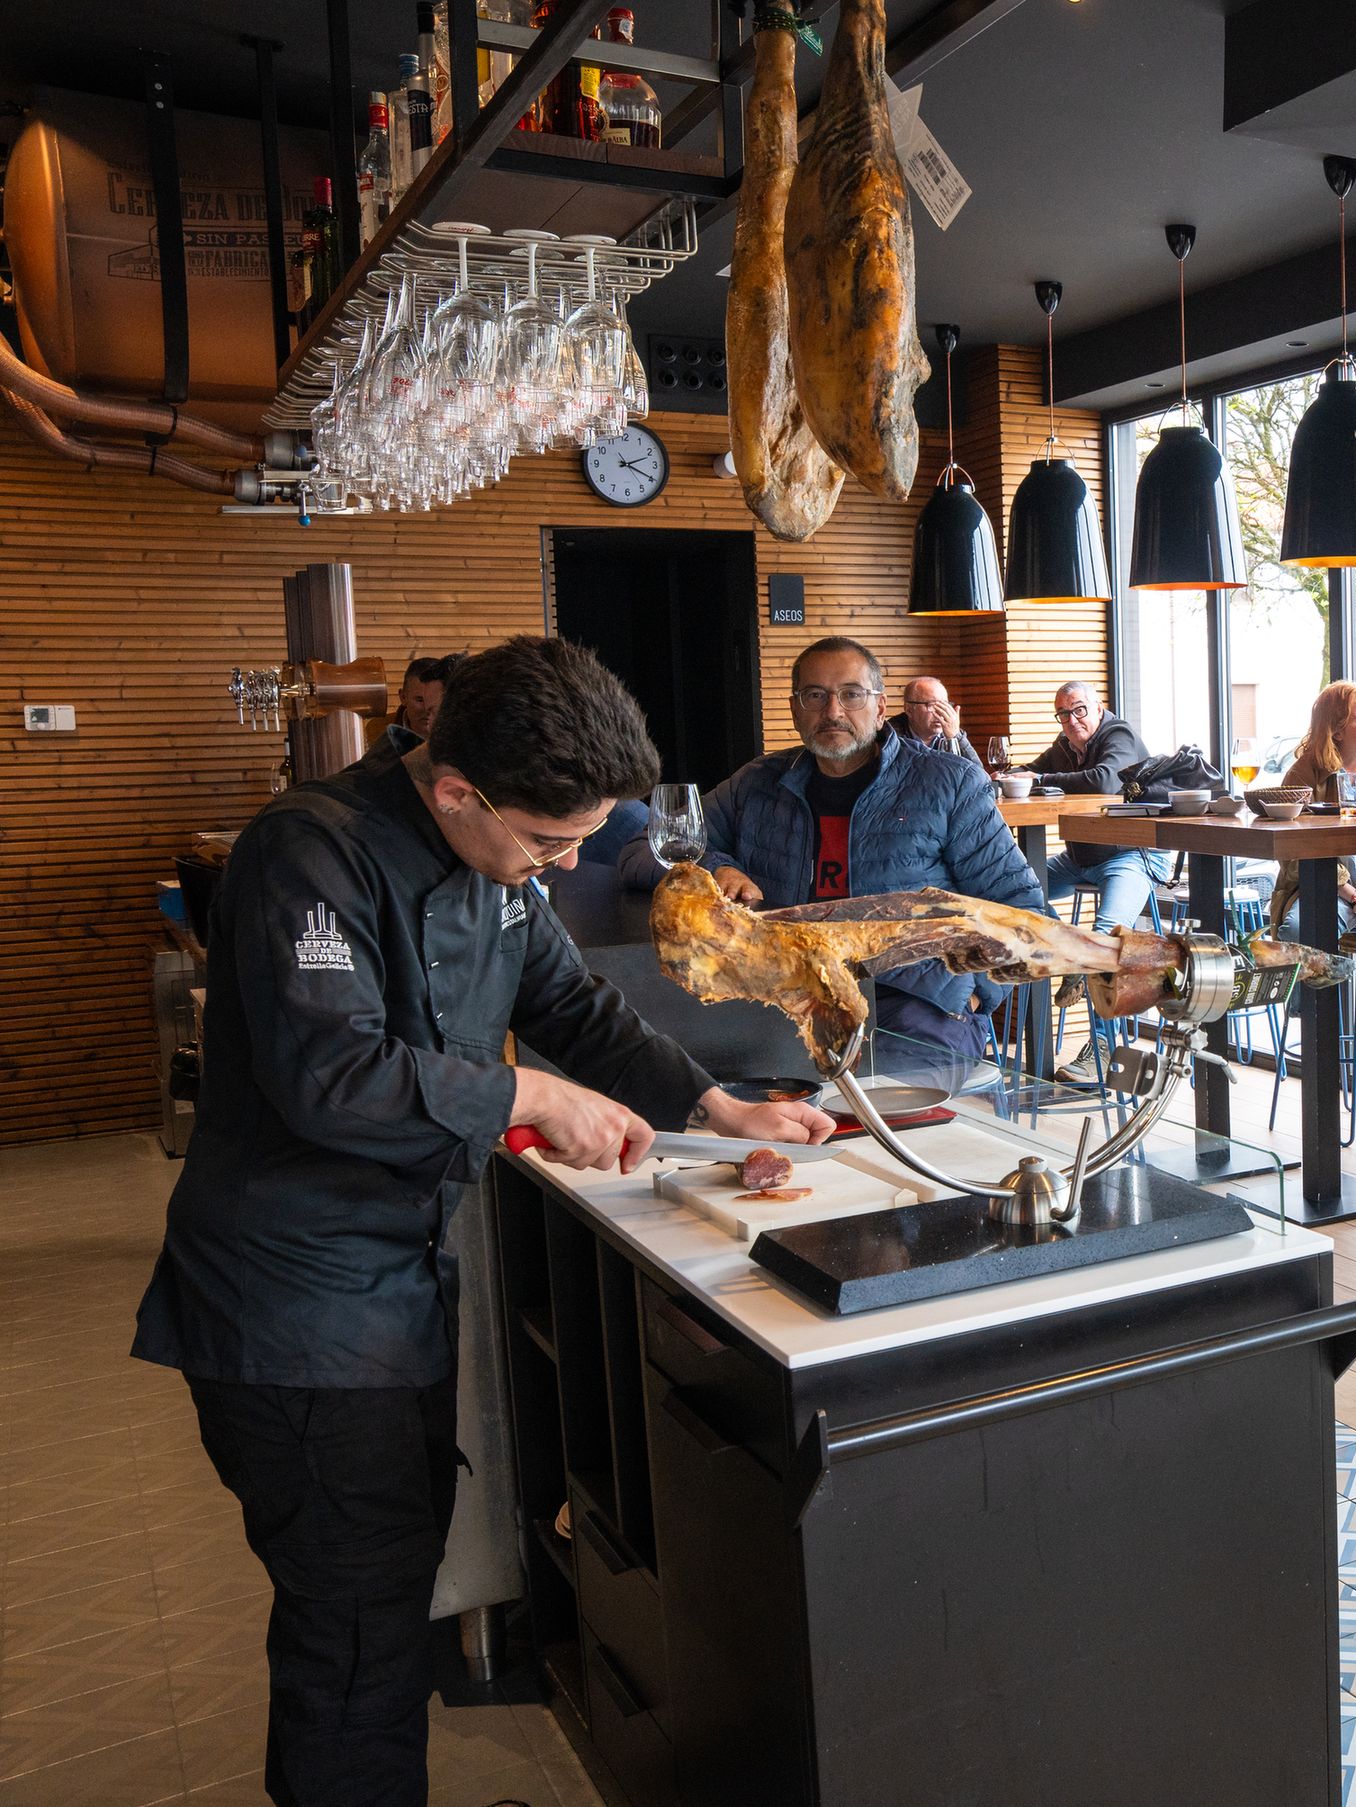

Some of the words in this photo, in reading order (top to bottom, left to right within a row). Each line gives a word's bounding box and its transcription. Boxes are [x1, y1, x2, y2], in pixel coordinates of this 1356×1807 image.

[108, 172, 229, 220] CEREZA
[197, 233, 228, 245] SIN
[597, 446, 606, 455] 10
[646, 448, 653, 456] 2
[593, 459, 599, 468] 9
[652, 461, 658, 469] 3
[599, 474, 605, 483] 8
[611, 484, 616, 492] 7
[625, 488, 631, 496] 6
[639, 484, 645, 493] 5
[774, 609, 803, 621] ASEOS
[295, 940, 351, 950] CERVEZA
[297, 953, 353, 964] BODEGA
